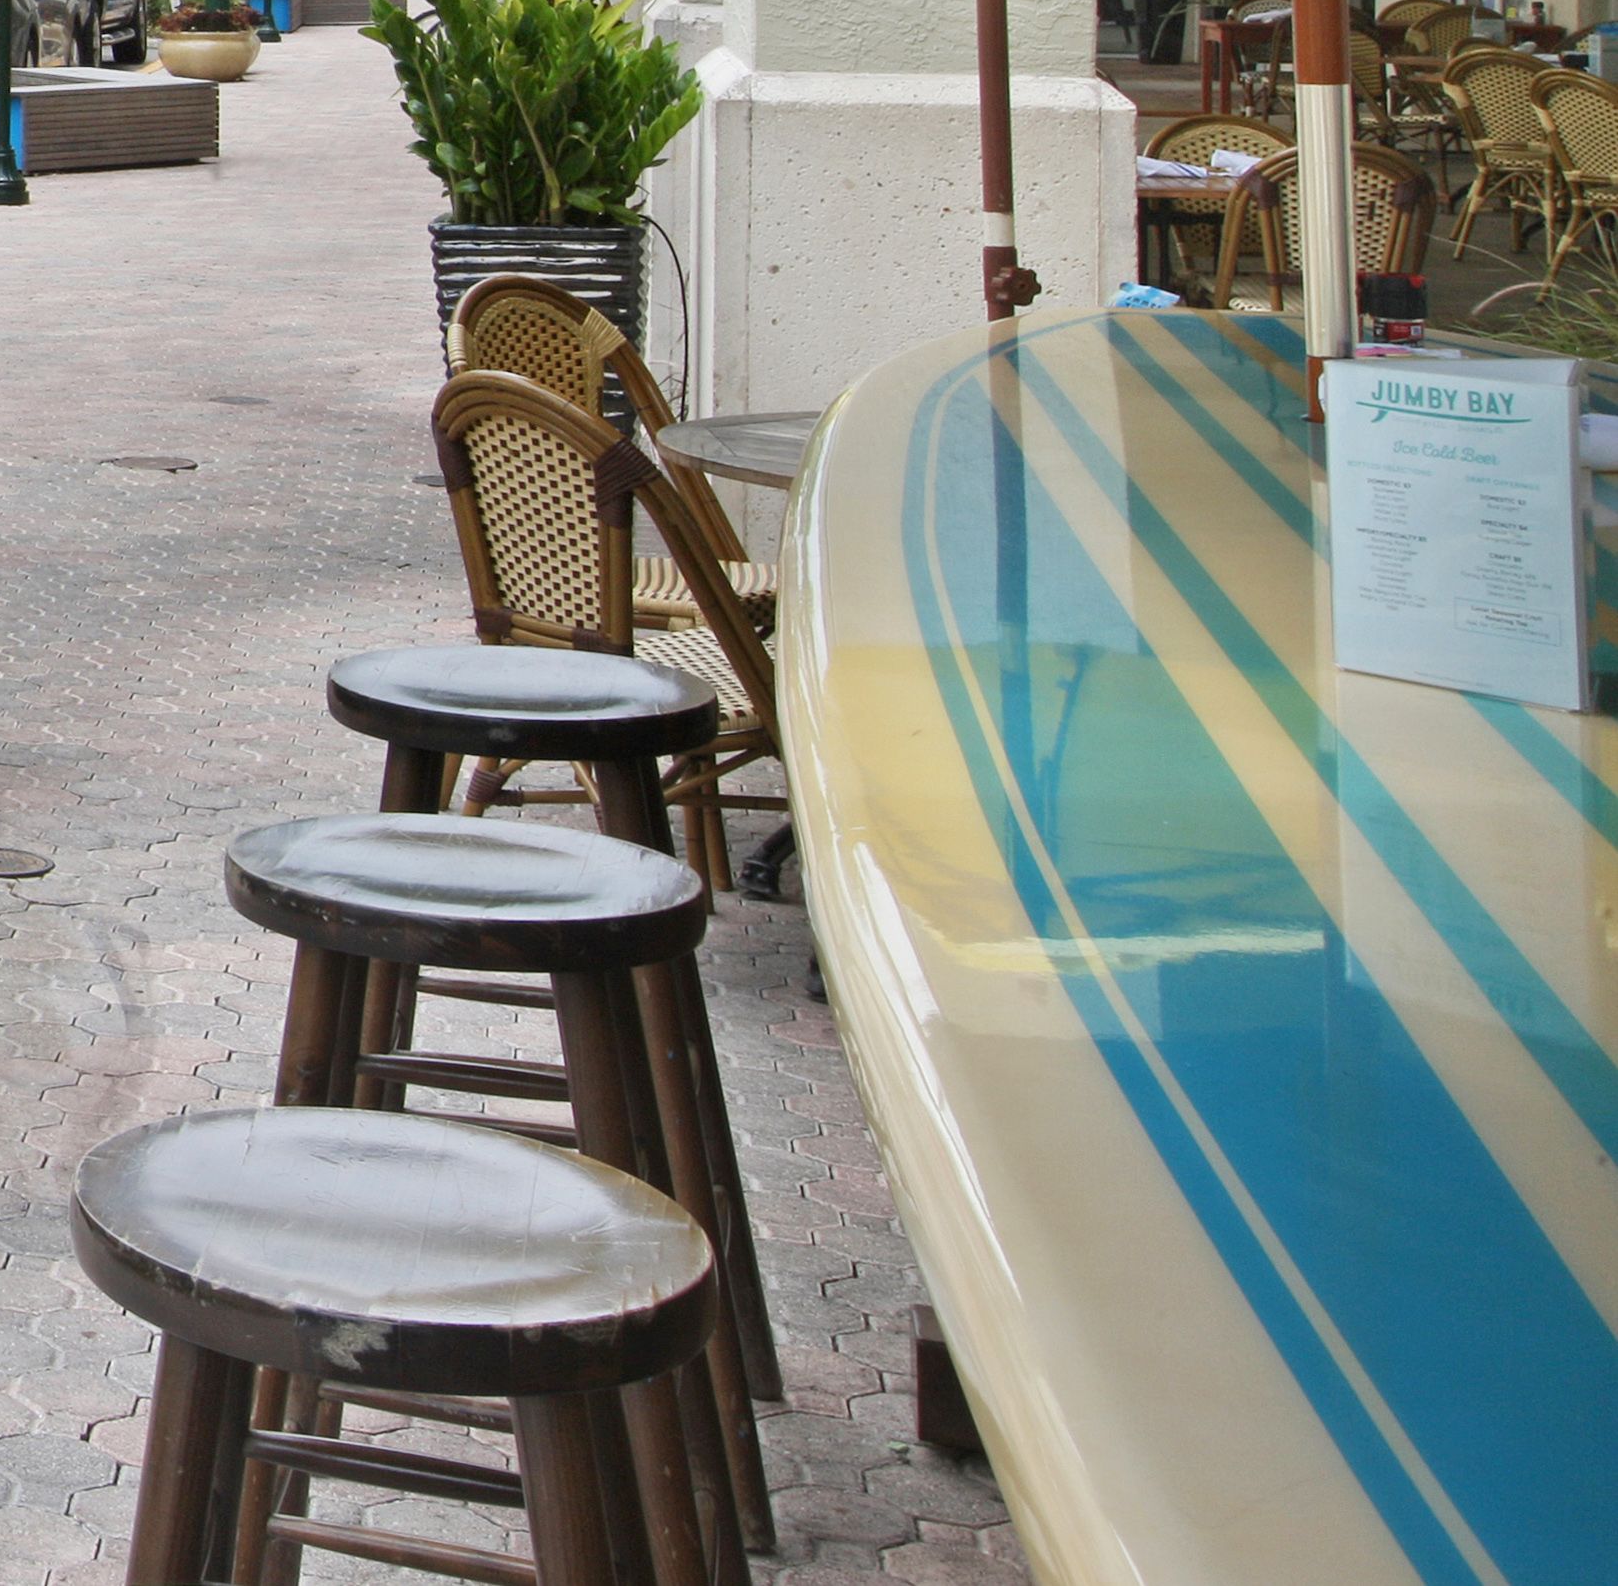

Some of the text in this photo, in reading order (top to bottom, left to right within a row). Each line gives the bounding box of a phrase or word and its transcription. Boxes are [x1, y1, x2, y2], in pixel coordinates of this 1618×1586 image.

[1371, 380, 1515, 416] JUMBY BAY
[1392, 438, 1501, 467] Ice Cold Beer
